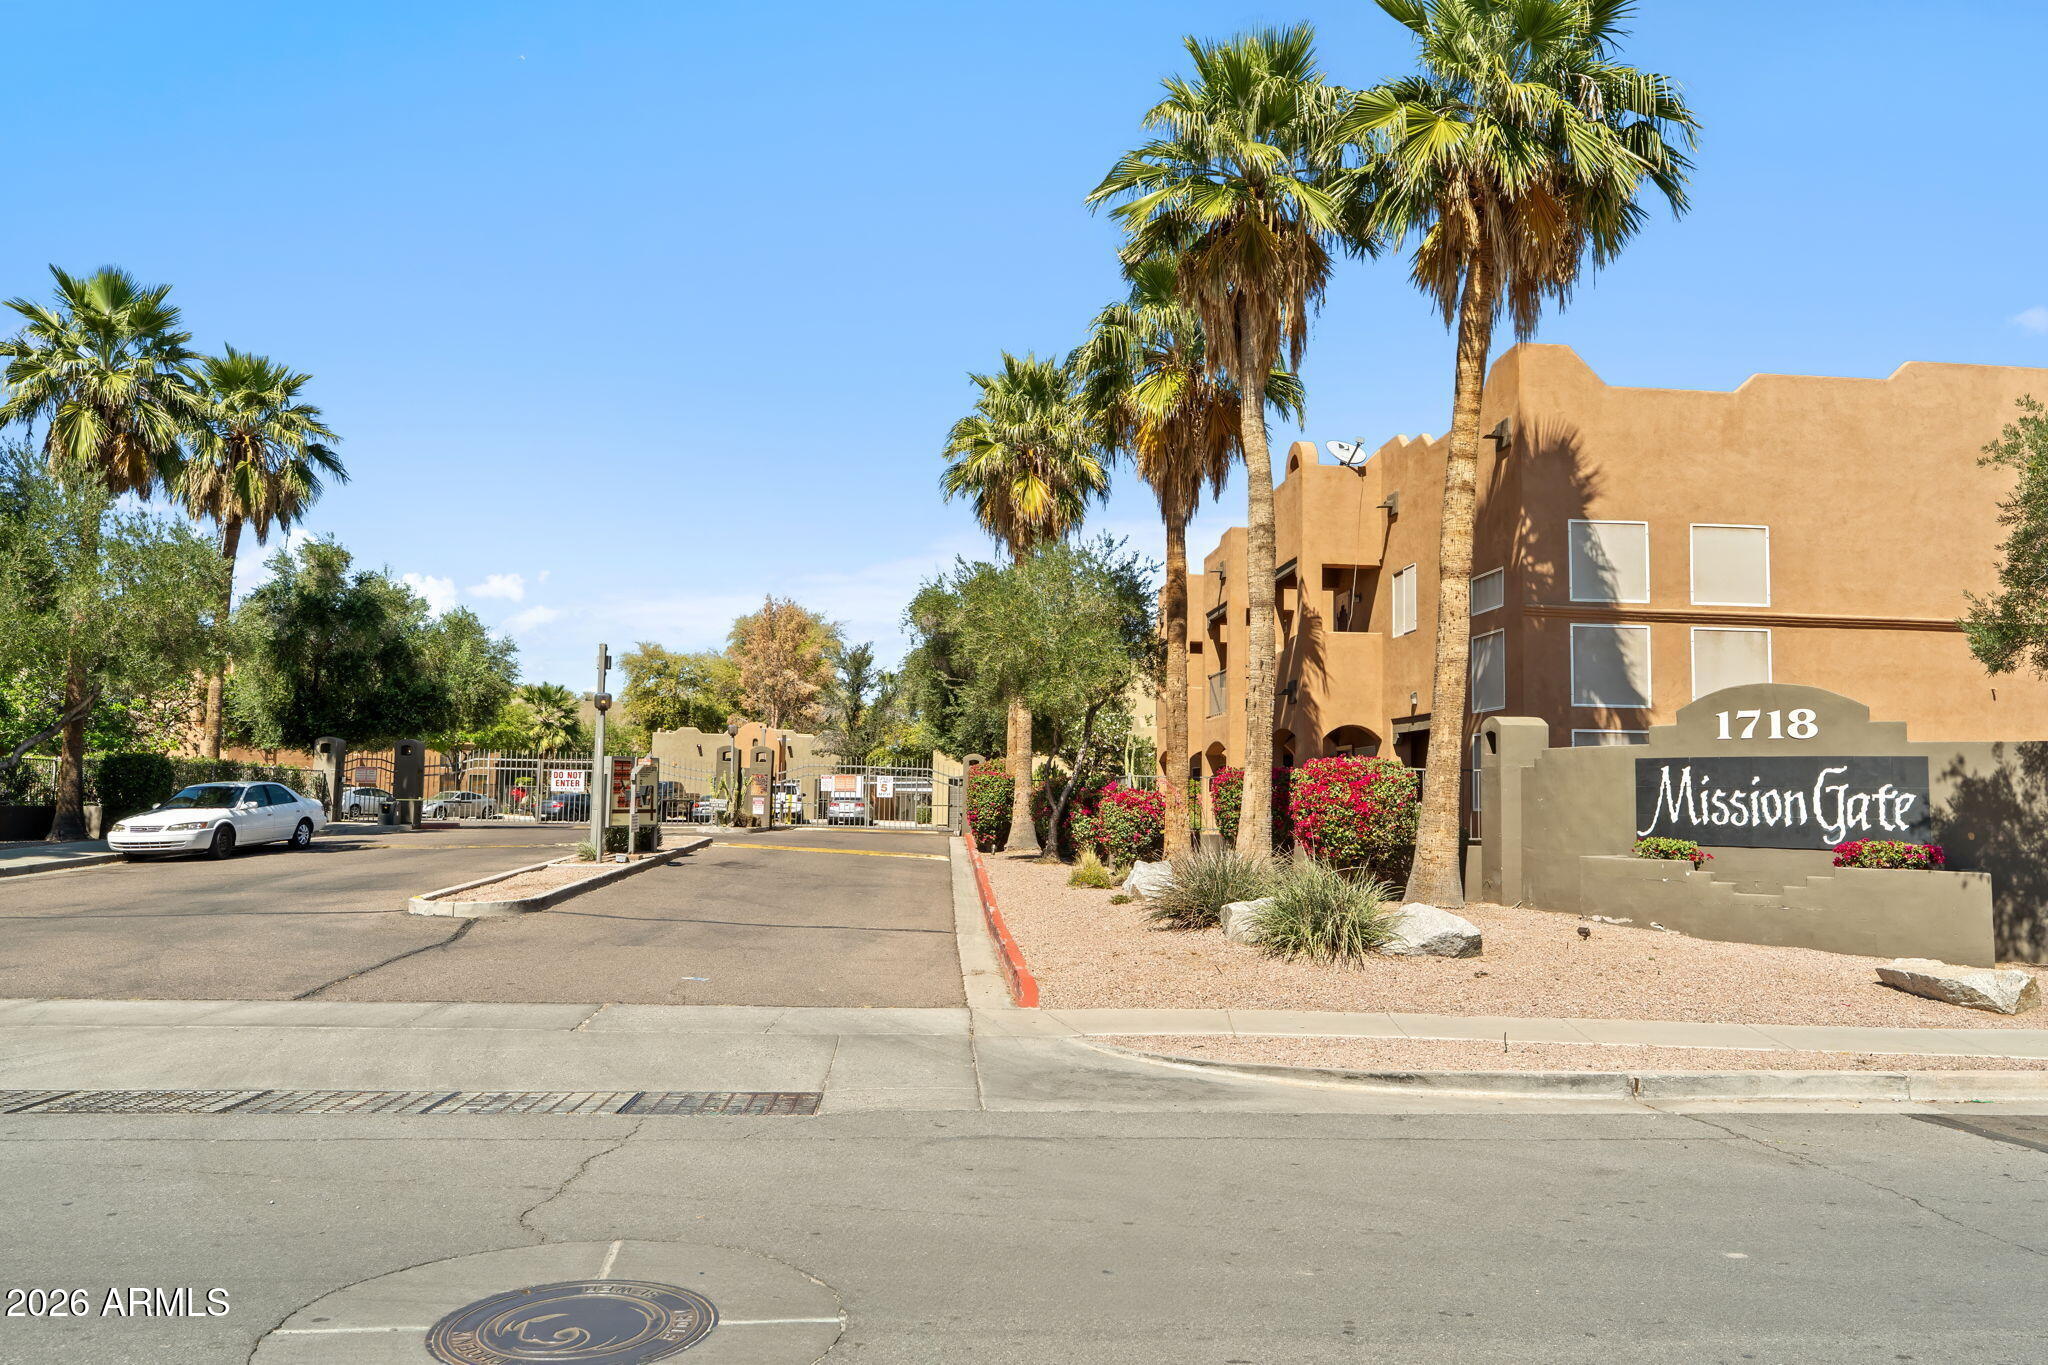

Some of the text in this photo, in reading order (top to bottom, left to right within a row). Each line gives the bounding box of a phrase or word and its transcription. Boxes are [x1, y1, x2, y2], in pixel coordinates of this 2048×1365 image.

[1715, 708, 1819, 740] 1718
[553, 771, 583, 779] DO NOT
[555, 779, 580, 787] ENTER
[880, 783, 888, 792] 5
[1637, 765, 1917, 845] Mission Gate
